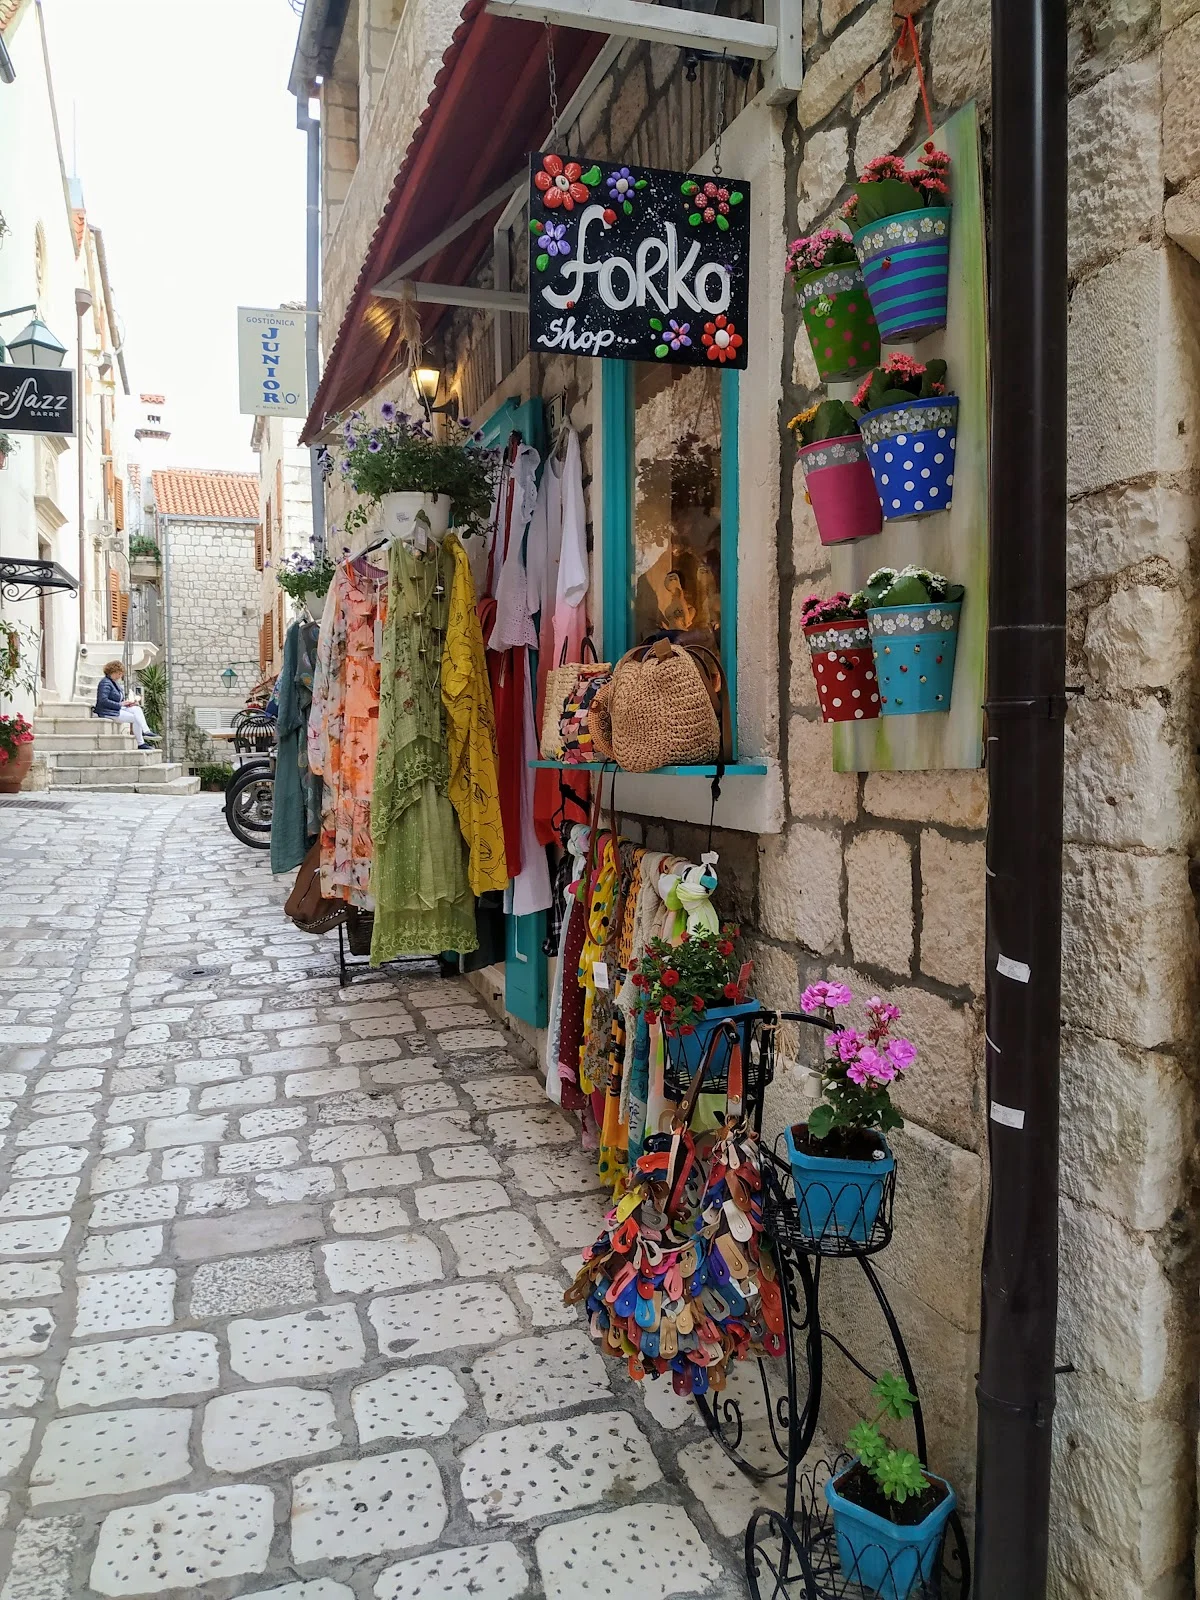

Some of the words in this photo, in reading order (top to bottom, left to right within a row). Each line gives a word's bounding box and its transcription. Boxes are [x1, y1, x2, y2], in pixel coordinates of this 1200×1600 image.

[246, 316, 295, 326] GOSTIONICA
[261, 327, 281, 403] JUNIOR
[30, 410, 60, 418] BARRR
